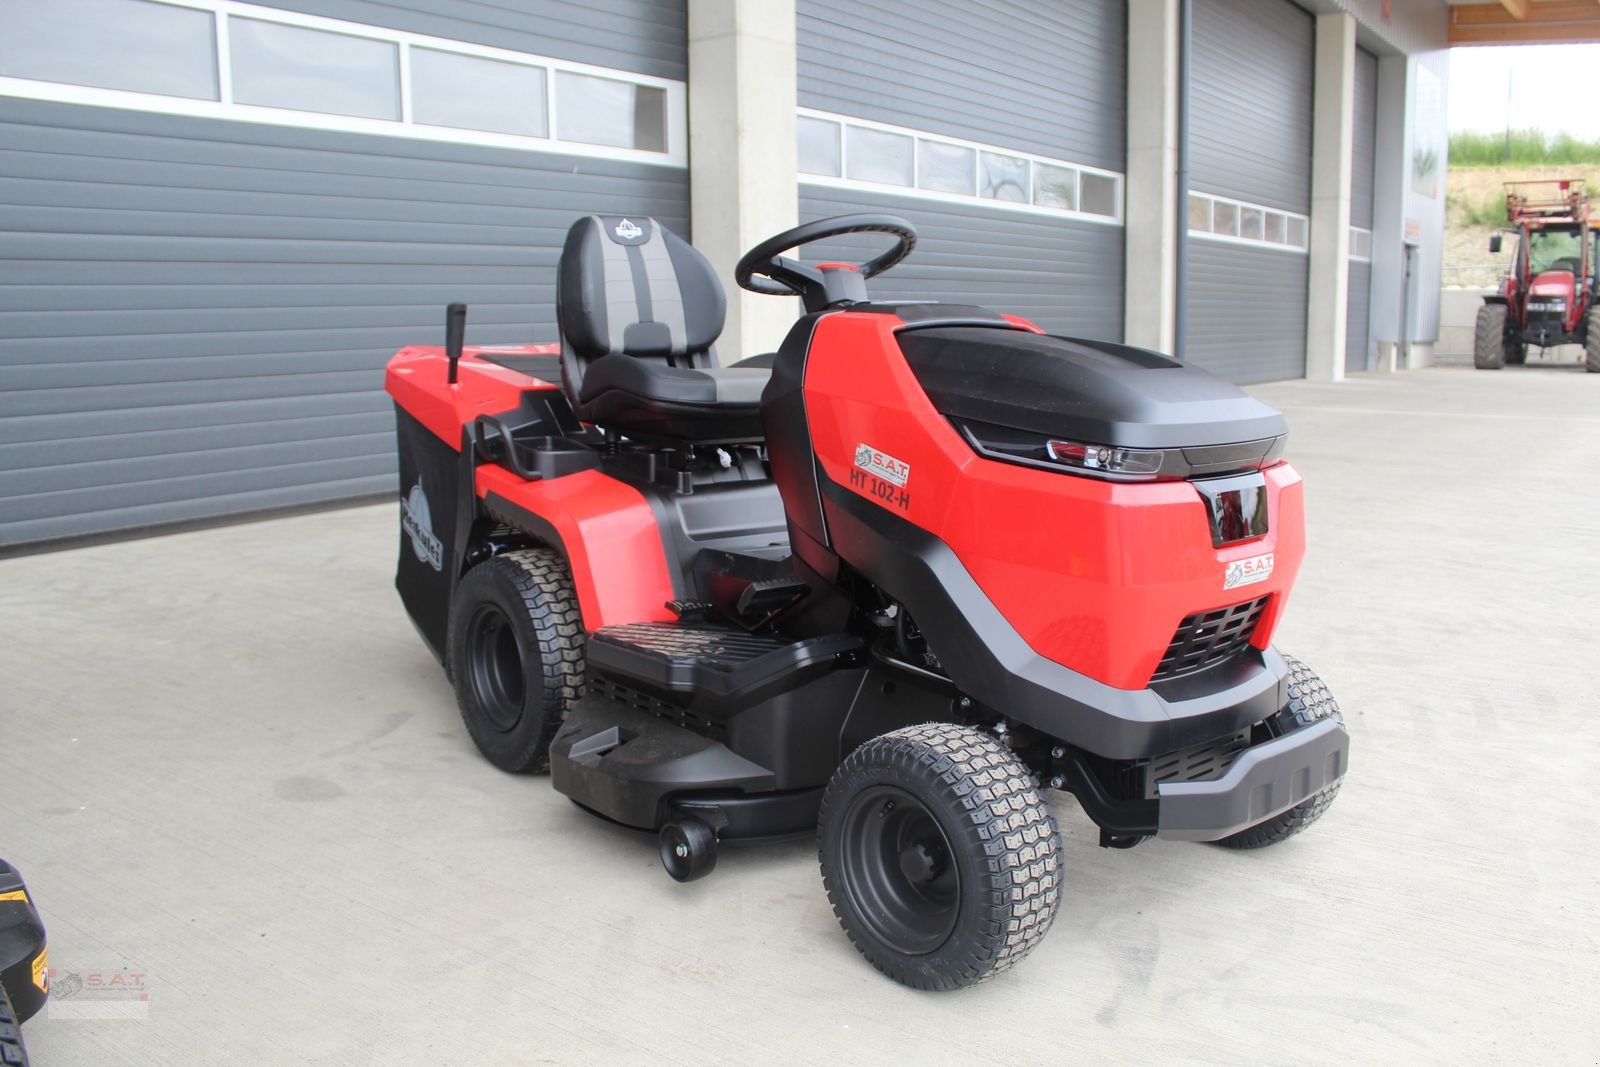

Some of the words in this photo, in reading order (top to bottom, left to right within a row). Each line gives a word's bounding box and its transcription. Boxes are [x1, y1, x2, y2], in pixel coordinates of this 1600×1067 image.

[873, 453, 908, 478] S.A.T.
[850, 468, 867, 489] HT
[870, 478, 910, 511] 102-H
[1244, 556, 1273, 574] S.A.T.
